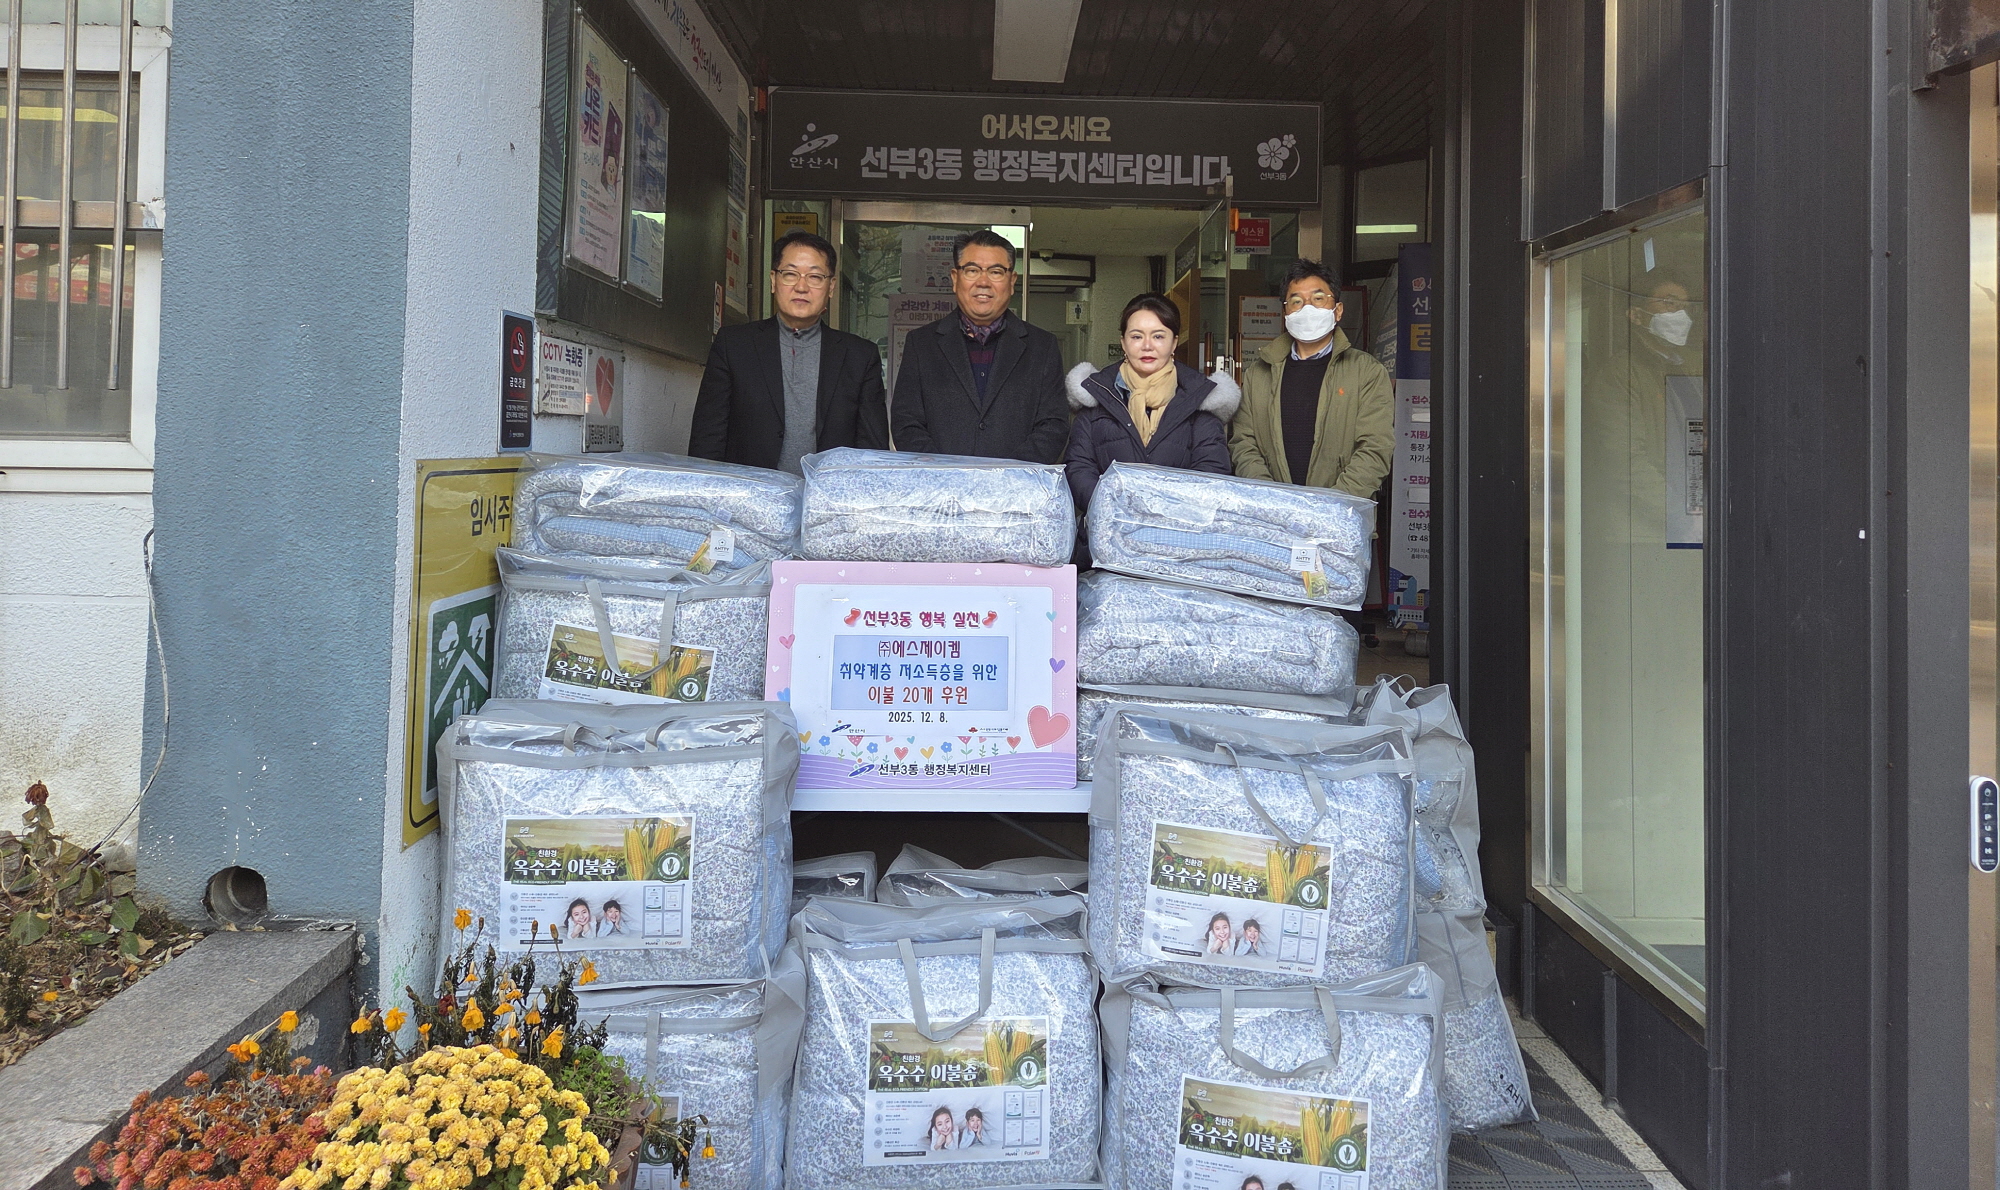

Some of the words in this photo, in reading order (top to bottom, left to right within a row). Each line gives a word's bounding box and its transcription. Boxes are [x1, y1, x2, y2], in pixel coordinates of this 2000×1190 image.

[981, 113, 1112, 143] 어서오세요
[789, 157, 838, 169] 안산시
[860, 146, 962, 181] 선부3동
[973, 149, 1232, 187] 행정복지센터입니다
[1259, 171, 1287, 181] 선부3동
[1240, 227, 1264, 237] 에스원
[901, 300, 930, 311] 건강한
[1412, 296, 1431, 315] 선
[543, 342, 563, 361] CCTV
[565, 345, 583, 368] 녹화중
[1412, 395, 1430, 404] 접수
[1411, 430, 1430, 440] 지원
[1410, 454, 1430, 463] 자기소
[471, 495, 512, 536] 임시주
[863, 611, 911, 628] 선부3동
[919, 611, 946, 628] 행복
[953, 611, 980, 628] 실천
[554, 660, 597, 680] 옥수수
[839, 663, 891, 681] 취약계층
[899, 663, 965, 681] 저소득층을
[972, 663, 997, 681] 위한
[868, 686, 895, 704] 이불
[903, 686, 933, 704] 20개
[941, 686, 968, 704] 후원
[888, 711, 915, 723] 2025.
[920, 711, 934, 723] 12.
[938, 711, 948, 723] 8.
[878, 763, 918, 777] 선부3동
[924, 764, 991, 777] 행정복지센터
[1984, 813, 1992, 854] PUSH
[538, 849, 557, 858] 친환경
[512, 859, 562, 876] 옥수수
[568, 859, 618, 876] 이불솜
[1184, 857, 1203, 868] 친환경
[1160, 864, 1208, 886] 옥수수
[1212, 872, 1259, 894] 이불솜
[902, 1054, 921, 1063] 친환경
[878, 1065, 926, 1082] 옥수수
[931, 1064, 978, 1082] 이불솜
[1215, 1116, 1234, 1127] 친환경
[1189, 1123, 1239, 1148] 옥수수
[1243, 1132, 1293, 1155] 이불솜
